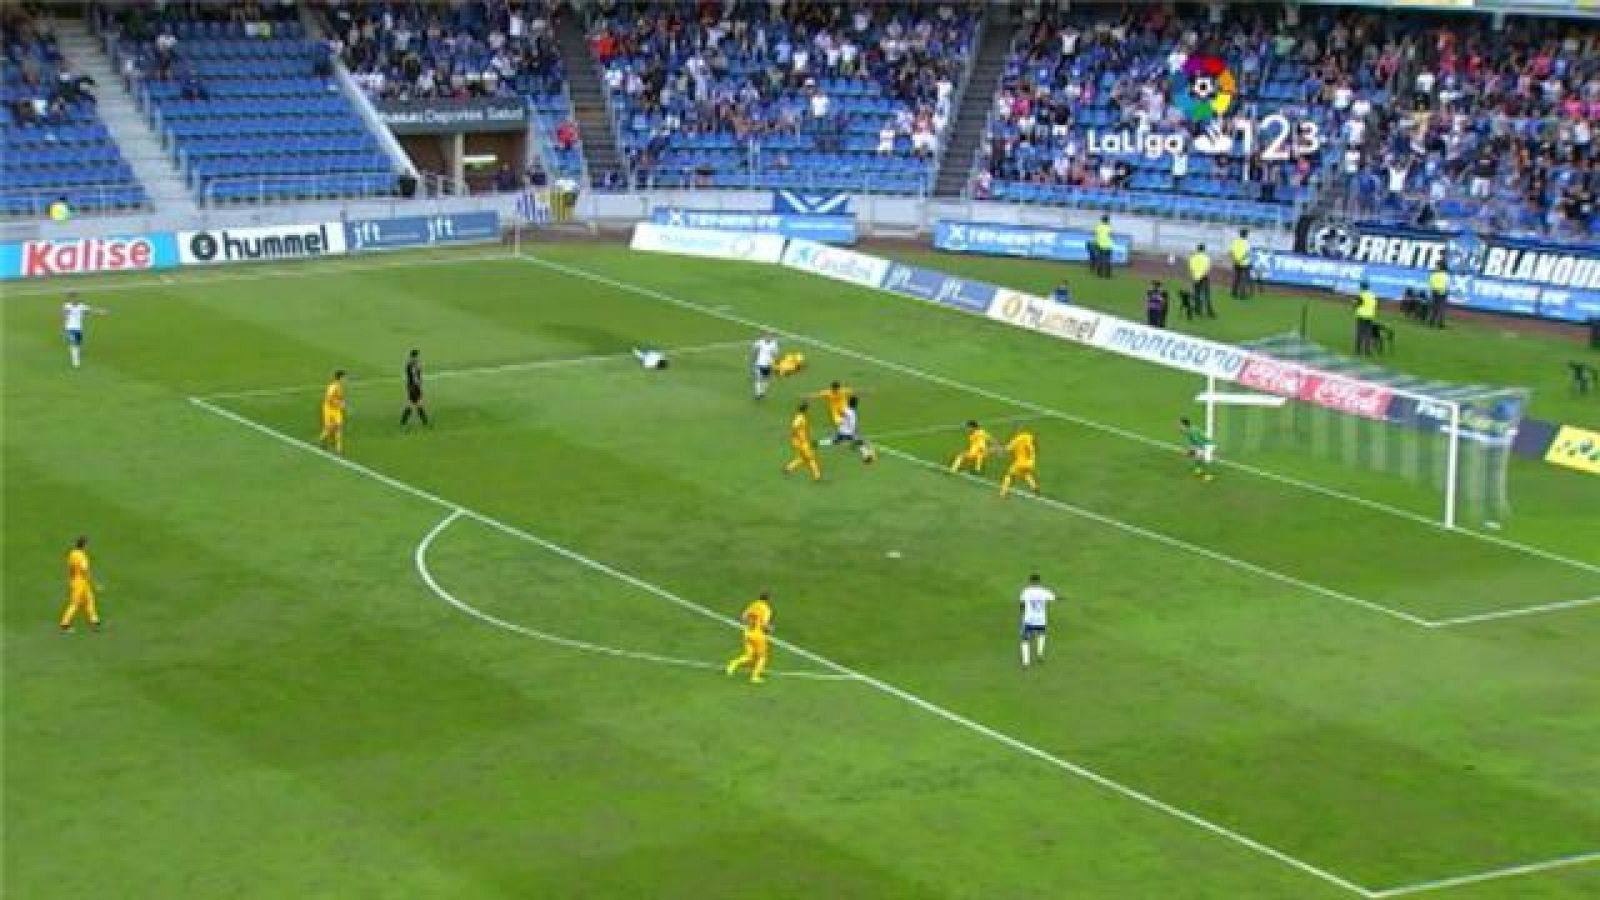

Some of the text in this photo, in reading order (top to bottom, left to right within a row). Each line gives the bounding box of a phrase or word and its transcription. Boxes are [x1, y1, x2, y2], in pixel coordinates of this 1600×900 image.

[22, 238, 150, 275] Kalise
[222, 224, 329, 258] hummel
[1358, 234, 1446, 268] FRENTE
